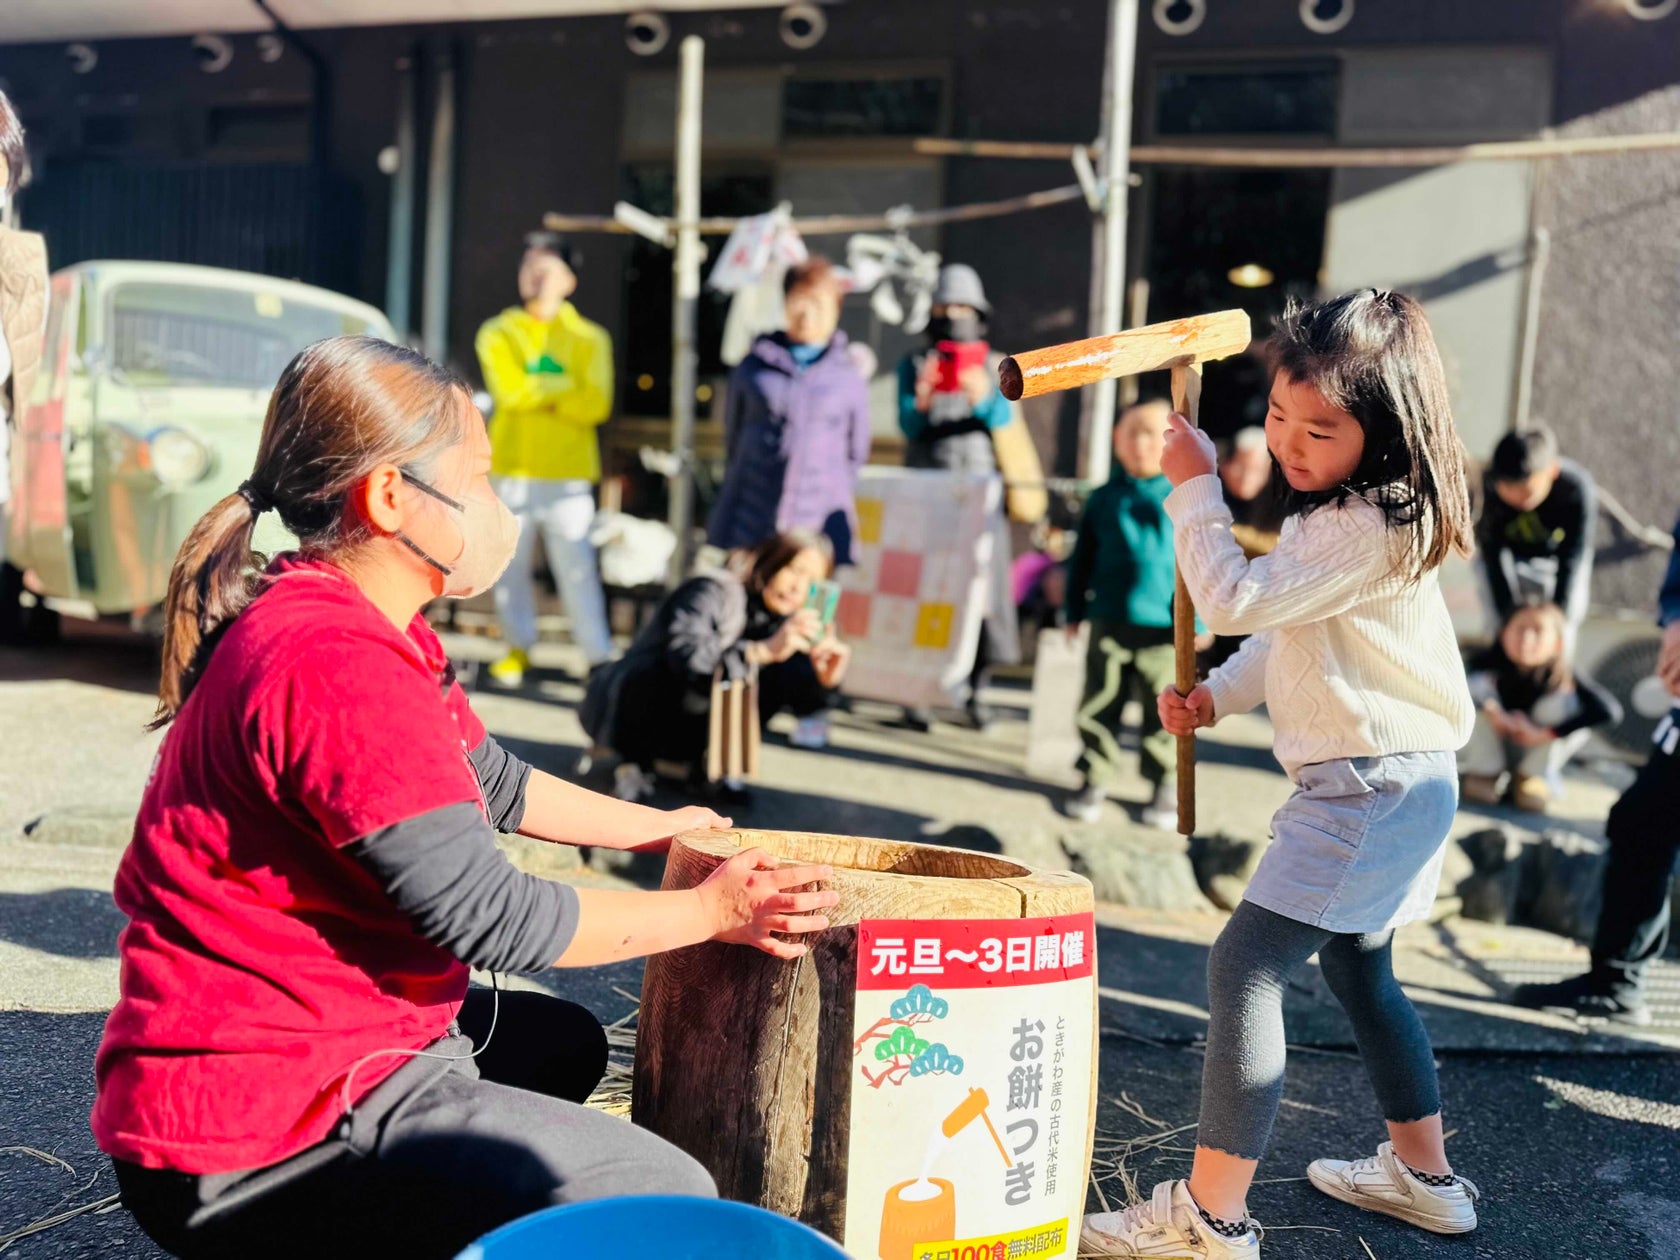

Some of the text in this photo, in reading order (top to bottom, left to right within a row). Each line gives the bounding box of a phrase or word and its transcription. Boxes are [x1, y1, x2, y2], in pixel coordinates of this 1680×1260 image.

[1004, 1018, 1046, 1206] お餅つき
[1044, 1015, 1066, 1197] ときがわ産の古代米使用
